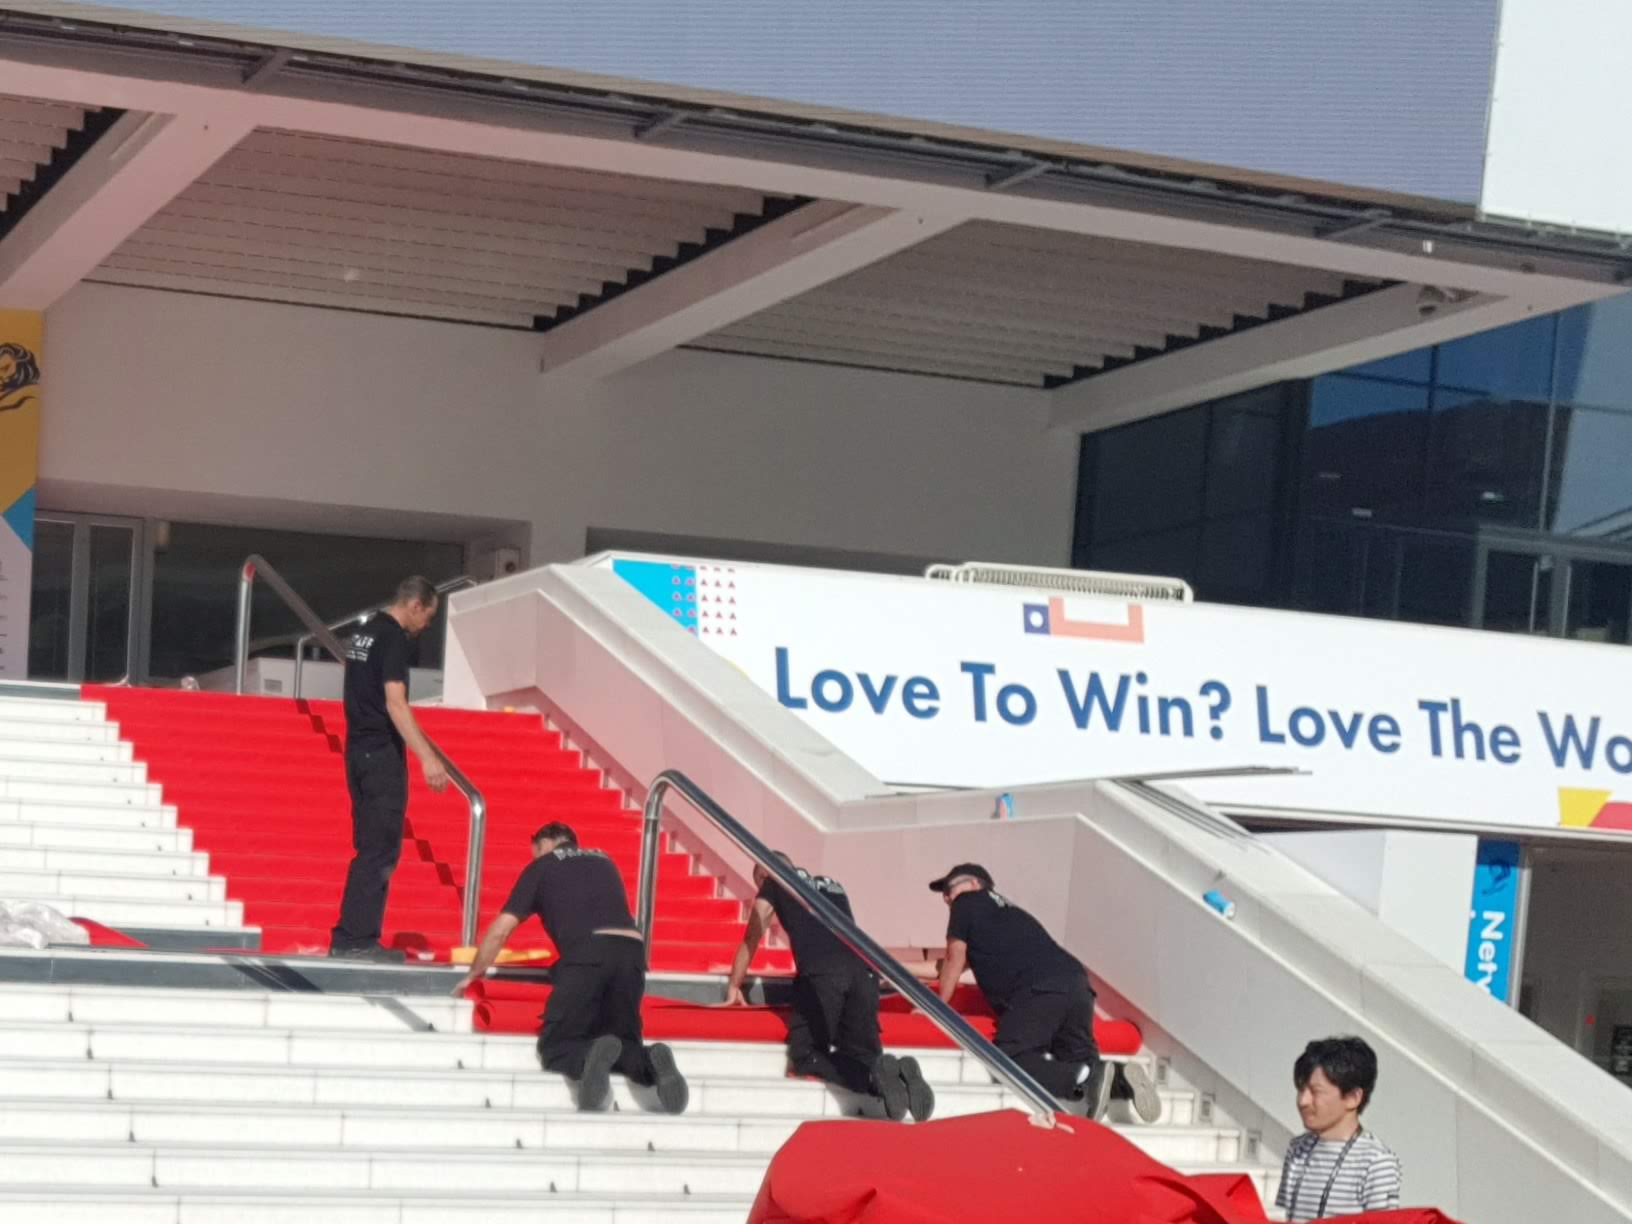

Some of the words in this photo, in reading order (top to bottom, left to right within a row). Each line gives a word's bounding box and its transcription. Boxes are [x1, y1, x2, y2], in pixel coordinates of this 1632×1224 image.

[775, 646, 940, 719] Love
[960, 661, 1038, 726] To
[1057, 668, 1233, 741] Win?
[1256, 684, 1402, 754] Love
[1418, 697, 1522, 764] The
